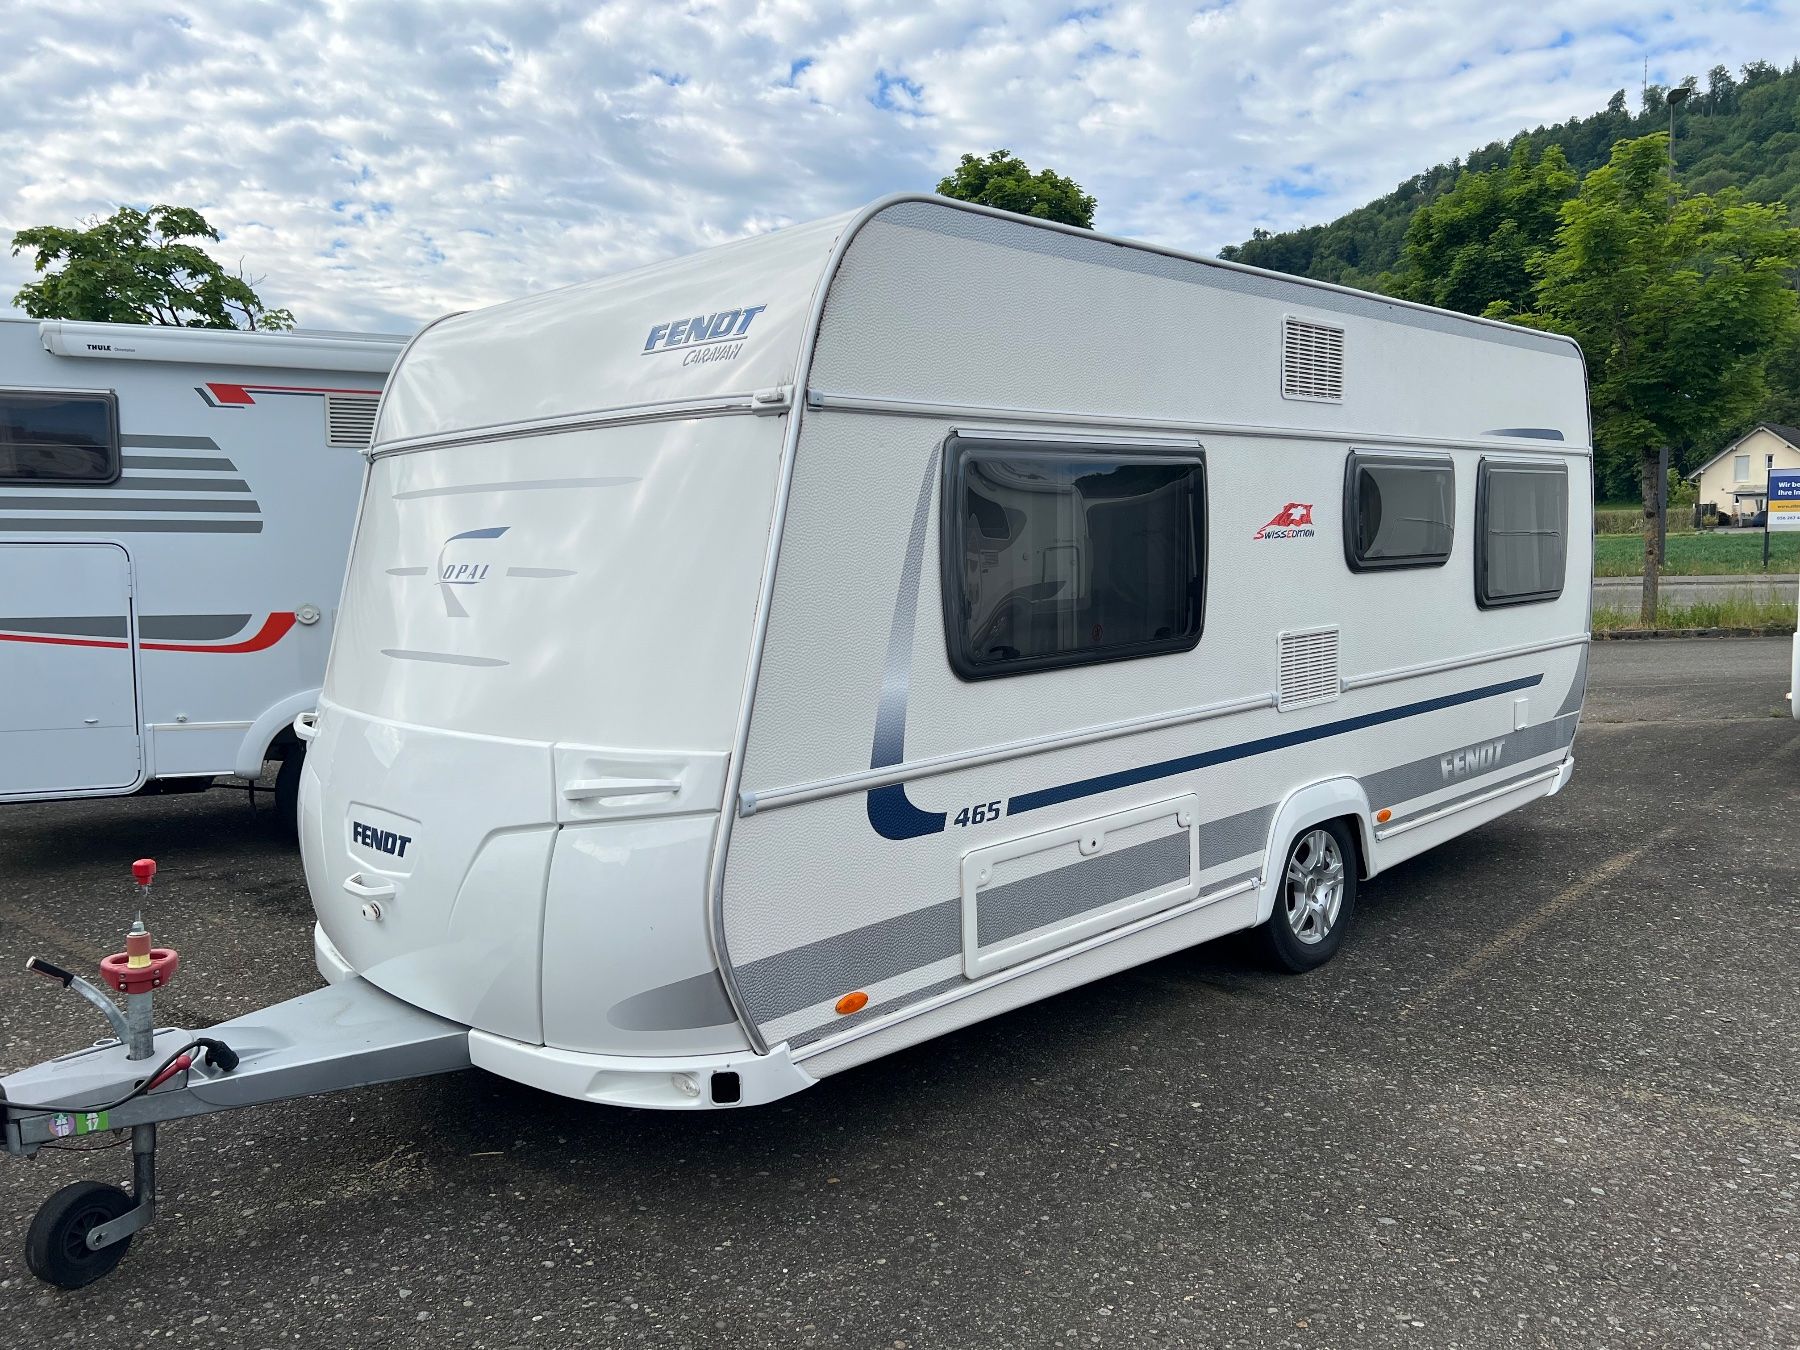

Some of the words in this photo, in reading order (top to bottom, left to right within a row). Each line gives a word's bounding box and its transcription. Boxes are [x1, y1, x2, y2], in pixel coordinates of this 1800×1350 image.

[644, 304, 767, 351] FENDT
[86, 344, 112, 352] THULE
[682, 343, 743, 367] CARAVAN
[442, 564, 490, 580] OPAL
[1440, 739, 1506, 780] FENDT
[953, 800, 1002, 827] 465
[353, 820, 412, 858] FENDT
